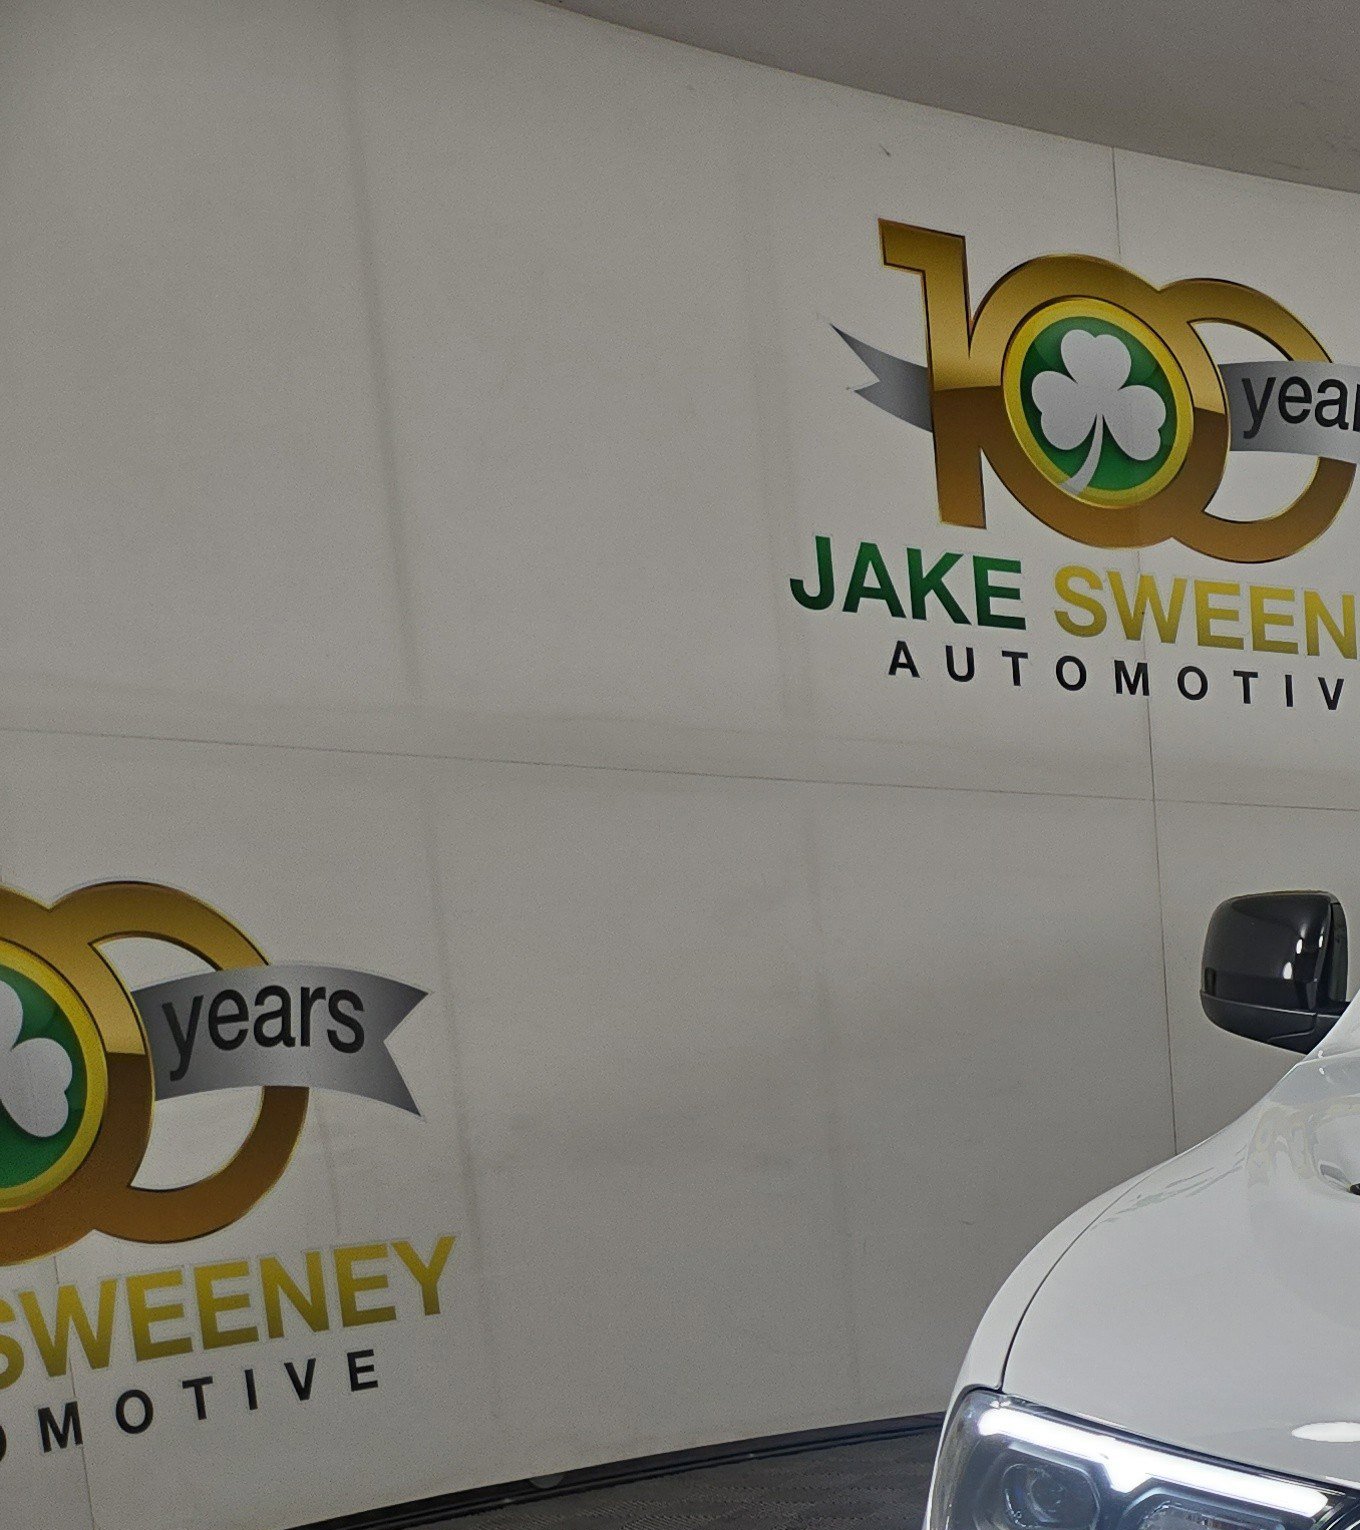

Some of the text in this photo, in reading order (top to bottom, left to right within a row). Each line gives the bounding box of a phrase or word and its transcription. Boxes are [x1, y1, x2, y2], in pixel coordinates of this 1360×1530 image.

[878, 217, 1357, 563] 100
[789, 536, 1027, 630] JAKE
[161, 985, 366, 1082] years
[0, 1349, 379, 1463] MOTIVE
